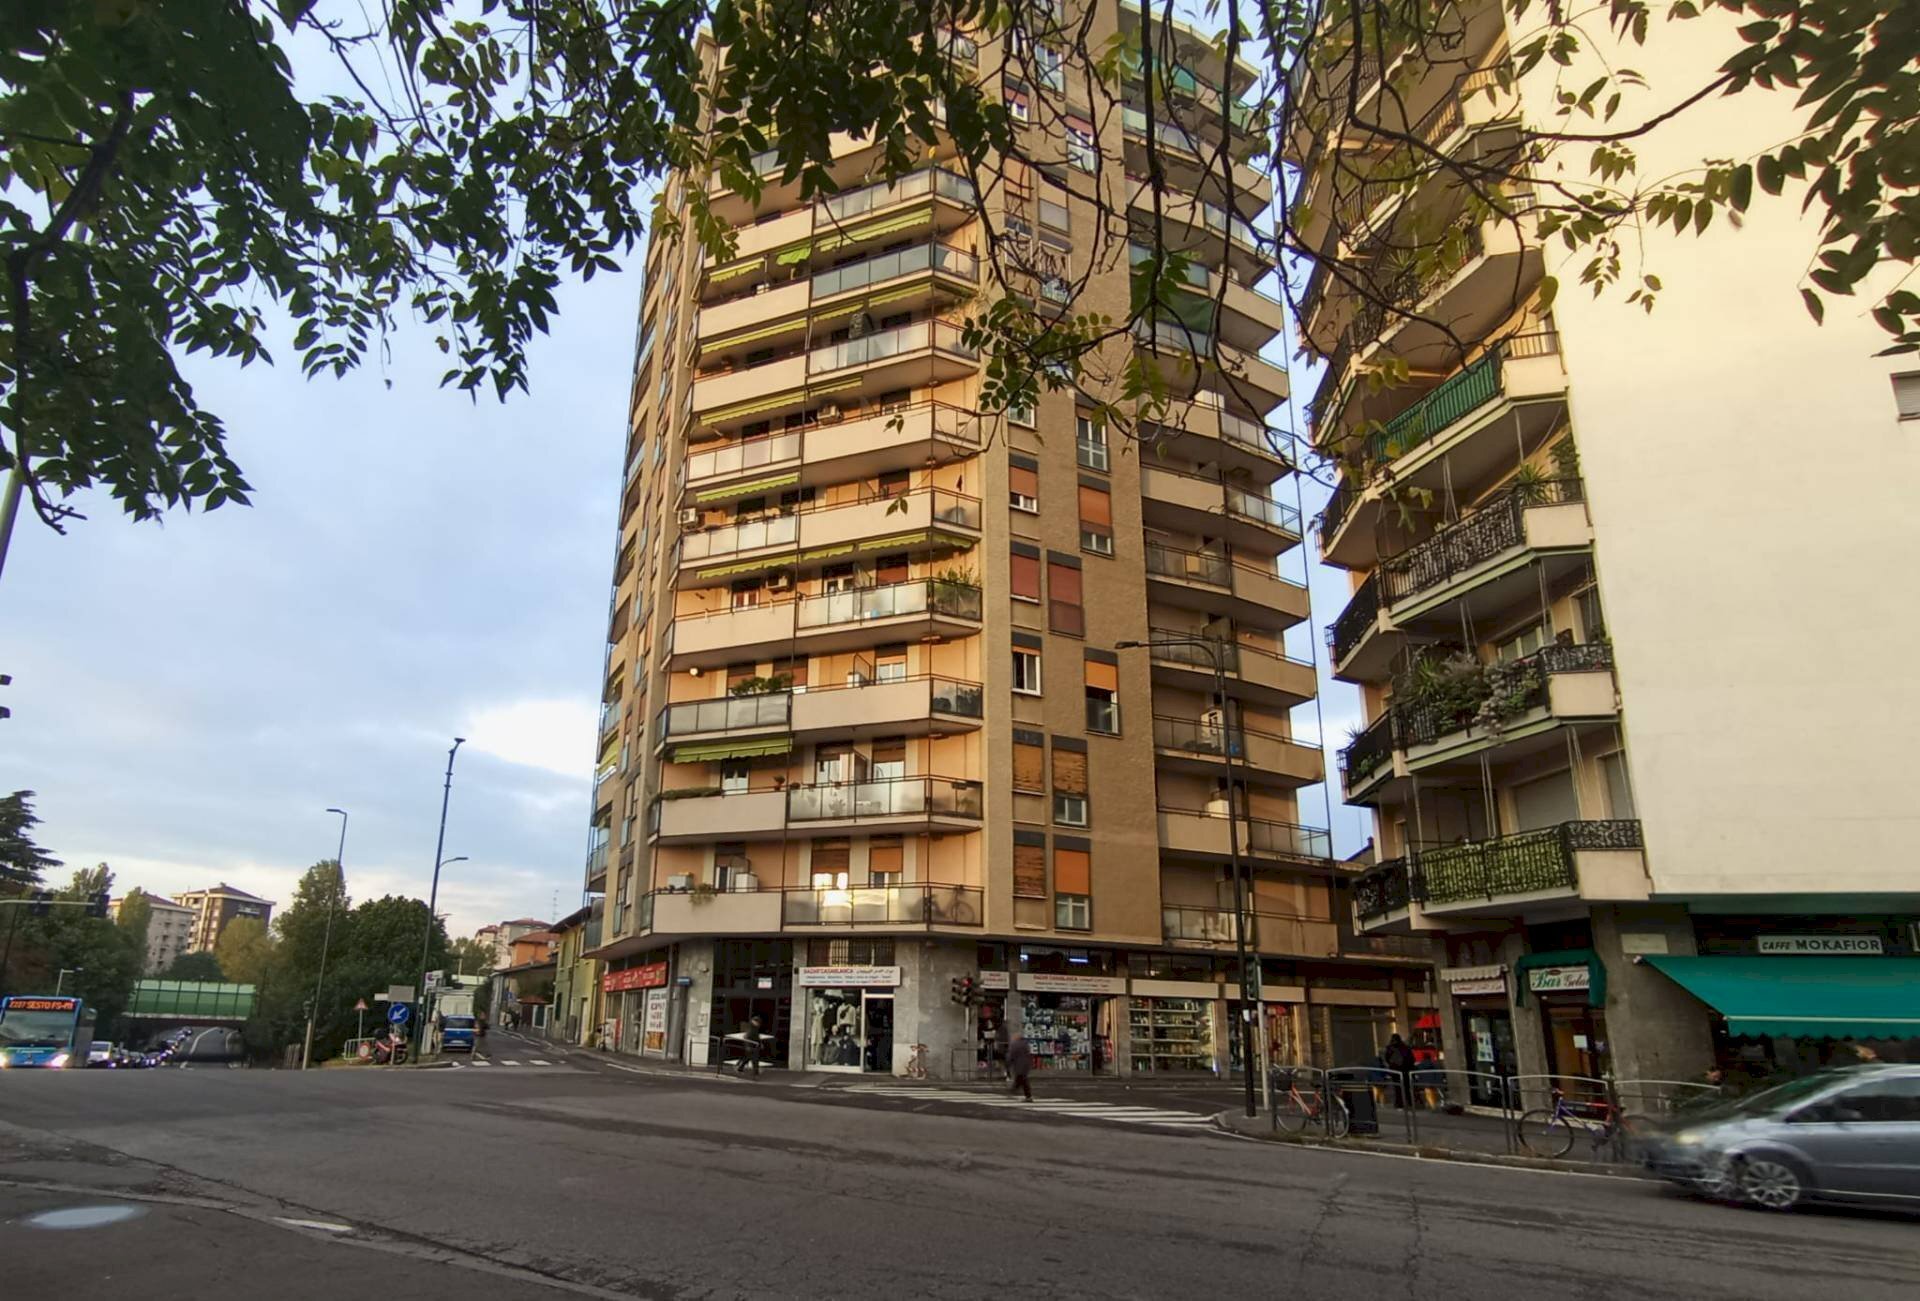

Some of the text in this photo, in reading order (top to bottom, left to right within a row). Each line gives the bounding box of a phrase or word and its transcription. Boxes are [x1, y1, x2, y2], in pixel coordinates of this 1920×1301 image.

[1795, 939, 1880, 951] MOKAFIOR
[1532, 970, 1562, 987] Bar
[26, 1001, 51, 1009] SESTO
